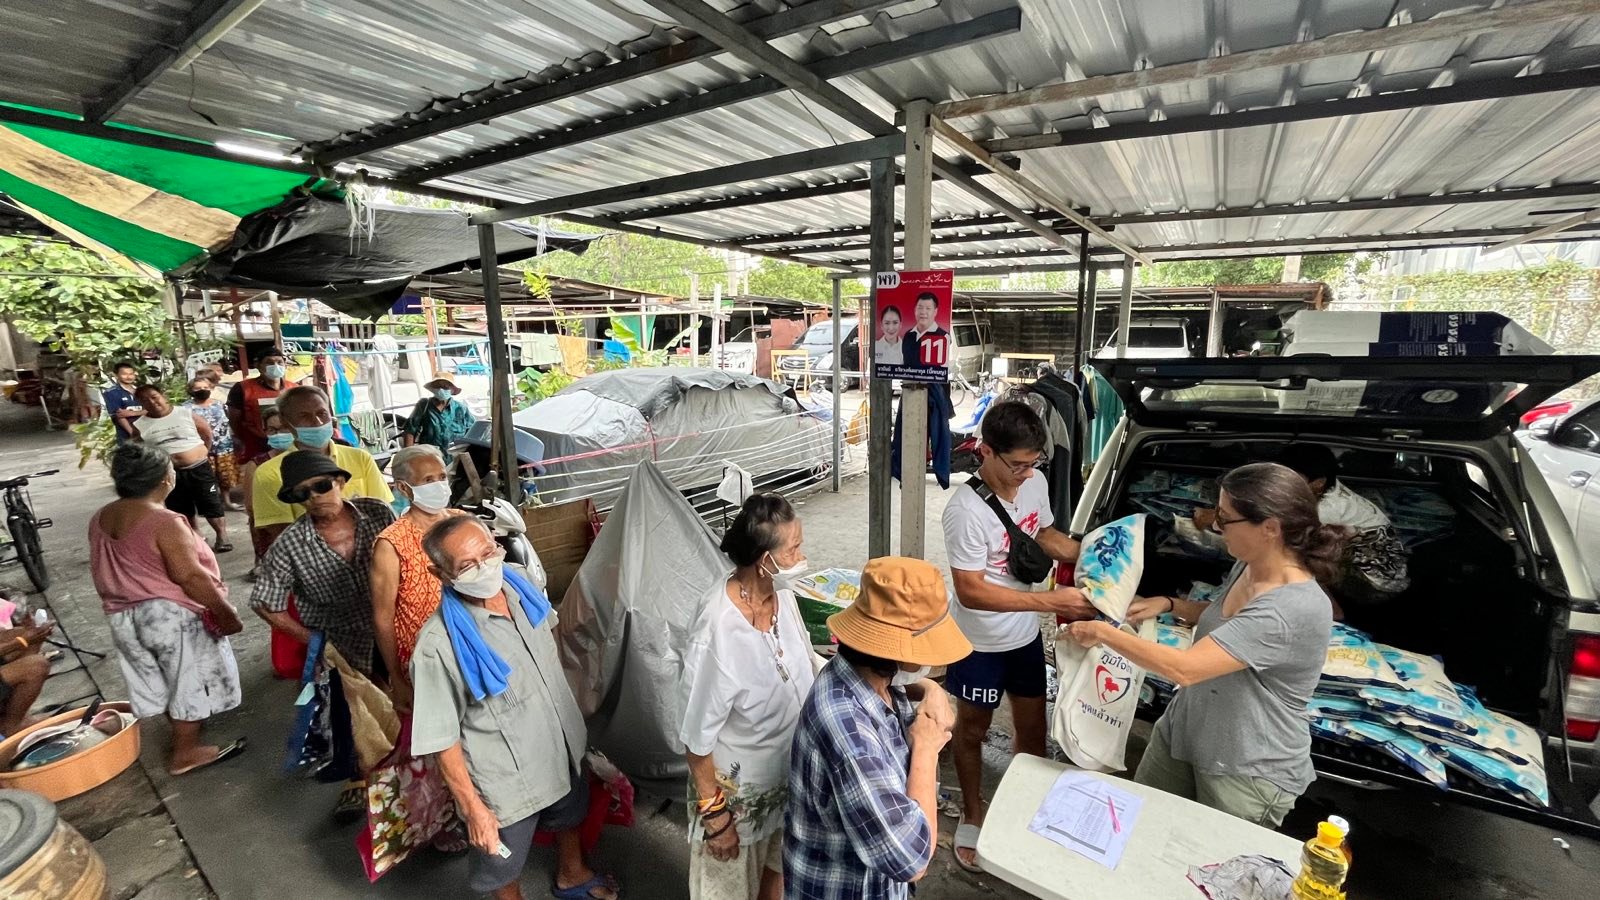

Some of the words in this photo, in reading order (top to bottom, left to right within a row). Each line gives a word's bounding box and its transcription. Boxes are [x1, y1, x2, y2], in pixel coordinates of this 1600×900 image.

[878, 274, 896, 286] พท
[921, 338, 944, 363] 11
[962, 684, 998, 703] LFIB
